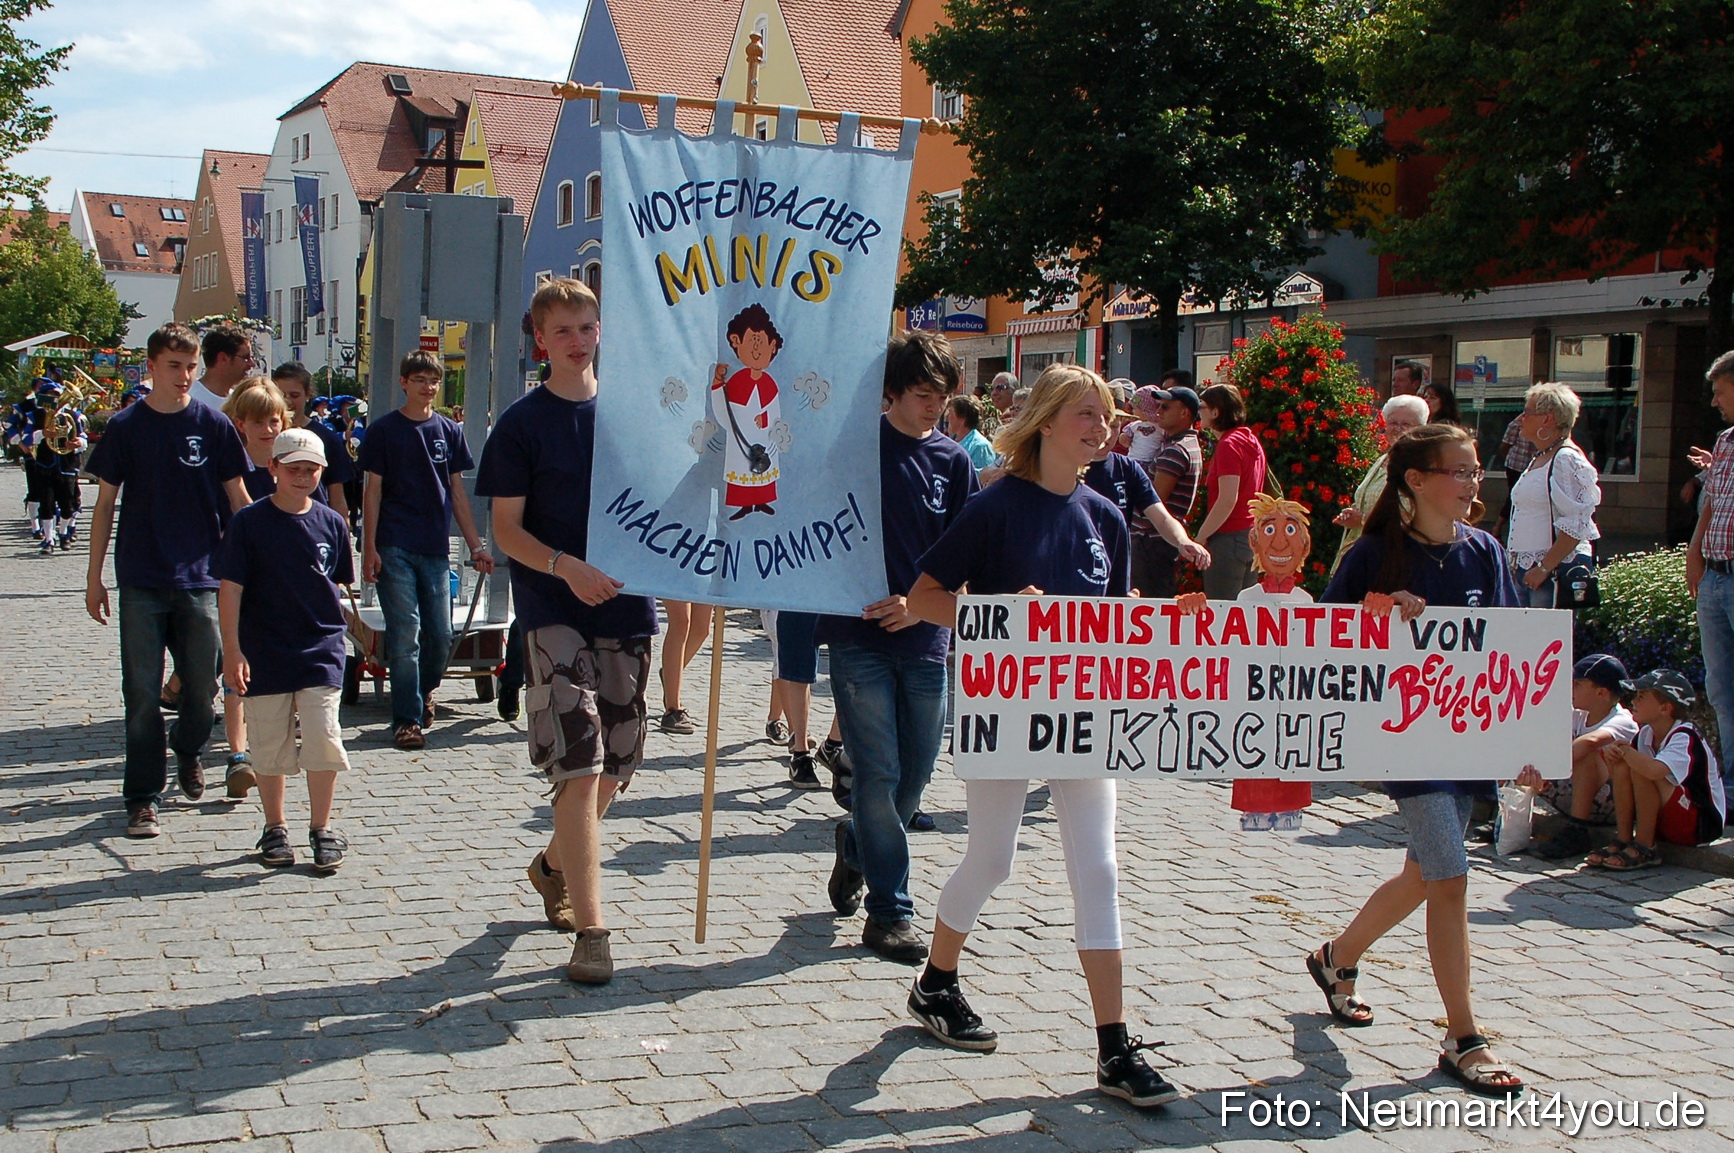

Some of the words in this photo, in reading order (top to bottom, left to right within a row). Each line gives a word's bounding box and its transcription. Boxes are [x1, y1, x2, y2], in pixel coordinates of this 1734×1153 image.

[628, 177, 882, 255] WOFFENBACHER
[655, 233, 843, 306] MINIS
[947, 320, 983, 329] Reisebüro
[605, 487, 741, 582] MACHEN
[754, 492, 868, 579] DAMPF!
[957, 604, 1010, 642] WIR
[1028, 600, 1391, 650] MINISTRANTEN
[1410, 617, 1487, 652] VON
[961, 651, 1230, 701] WOFFENBACH
[1247, 663, 1387, 702] BRINGEN
[1381, 640, 1563, 734] BEWEGUNG
[960, 713, 999, 753] IN
[1028, 711, 1094, 754] DIE
[1106, 703, 1346, 773] KIRCHE
